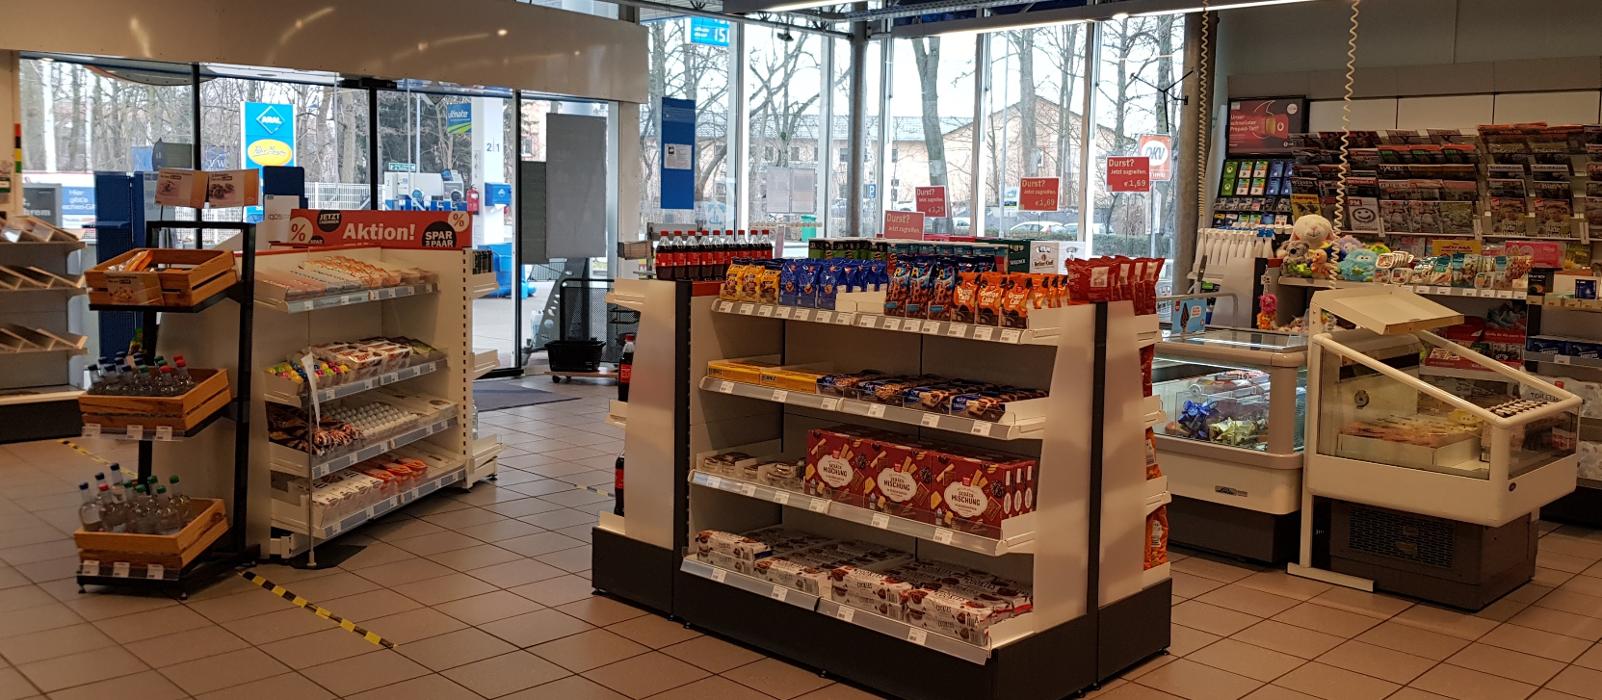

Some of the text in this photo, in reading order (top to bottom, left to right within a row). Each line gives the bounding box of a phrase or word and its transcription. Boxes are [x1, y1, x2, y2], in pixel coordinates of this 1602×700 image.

[486, 142, 500, 153] 2 1
[1108, 158, 1136, 167] Durst?
[1021, 179, 1046, 188] Durst?
[916, 188, 935, 197] Durst?
[320, 212, 341, 220] JETZT
[886, 213, 911, 223] Durst?
[343, 222, 416, 241] Aktion!
[425, 230, 453, 241] SPAR
[431, 240, 454, 248] PAAR
[823, 466, 848, 478] MISCHUNG
[884, 480, 911, 492] MISCHUNG
[951, 494, 981, 507] MISCHUNG
